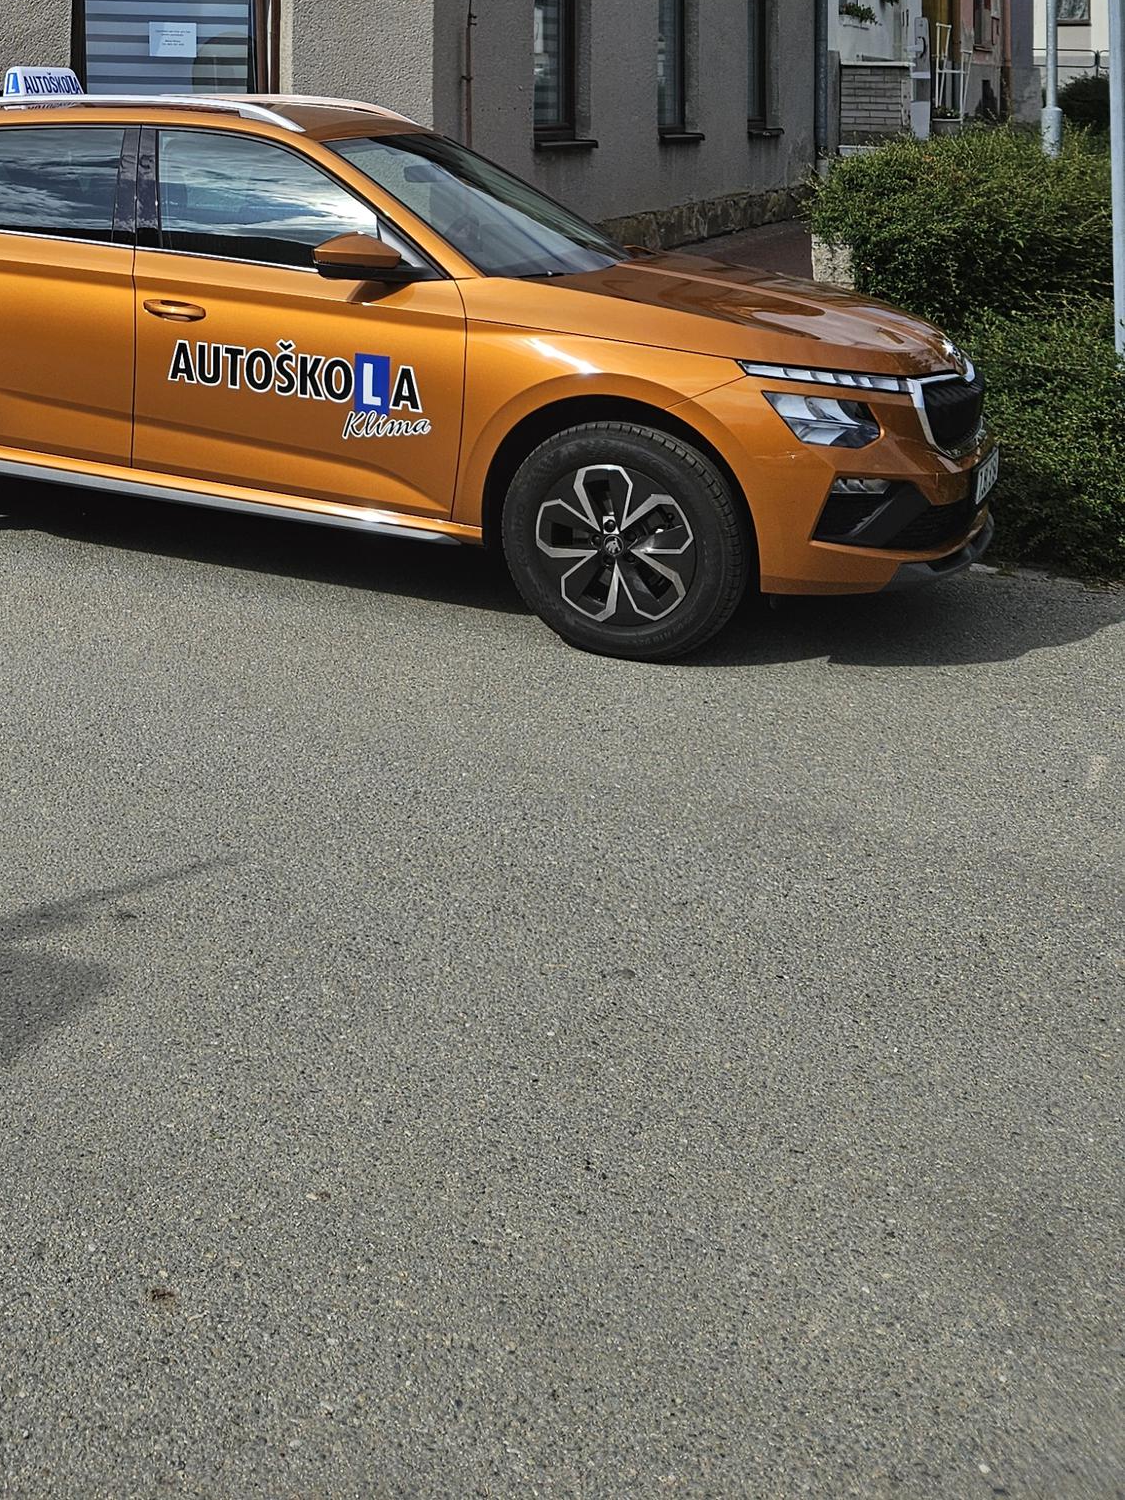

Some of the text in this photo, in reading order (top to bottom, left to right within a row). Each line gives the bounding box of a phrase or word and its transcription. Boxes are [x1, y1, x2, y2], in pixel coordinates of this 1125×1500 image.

[23, 71, 81, 95] AUTOŠKOLA
[168, 339, 422, 412] AUTOŠKOLA
[342, 410, 431, 439] Klima
